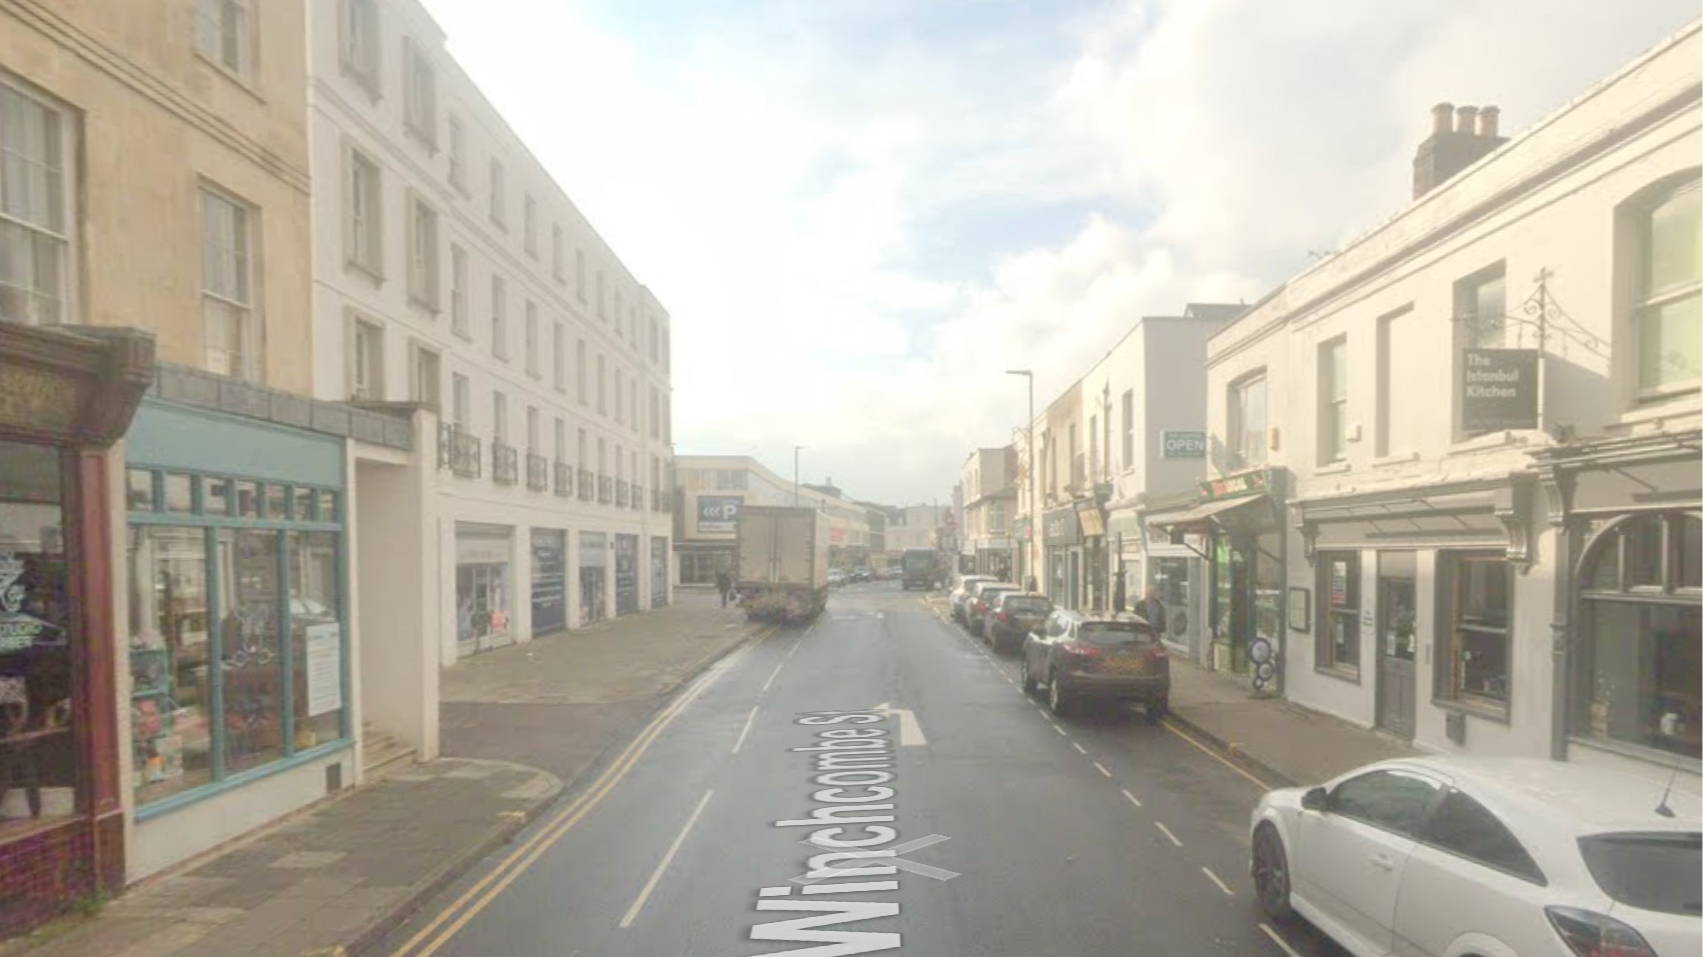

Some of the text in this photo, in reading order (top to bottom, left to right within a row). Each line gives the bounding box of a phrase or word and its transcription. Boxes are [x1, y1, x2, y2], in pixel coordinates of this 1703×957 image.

[1467, 353, 1491, 366] The
[1467, 369, 1519, 381] Istanbul
[1467, 385, 1517, 397] Kitchen
[1166, 439, 1204, 451] OPEN
[723, 504, 738, 520] P
